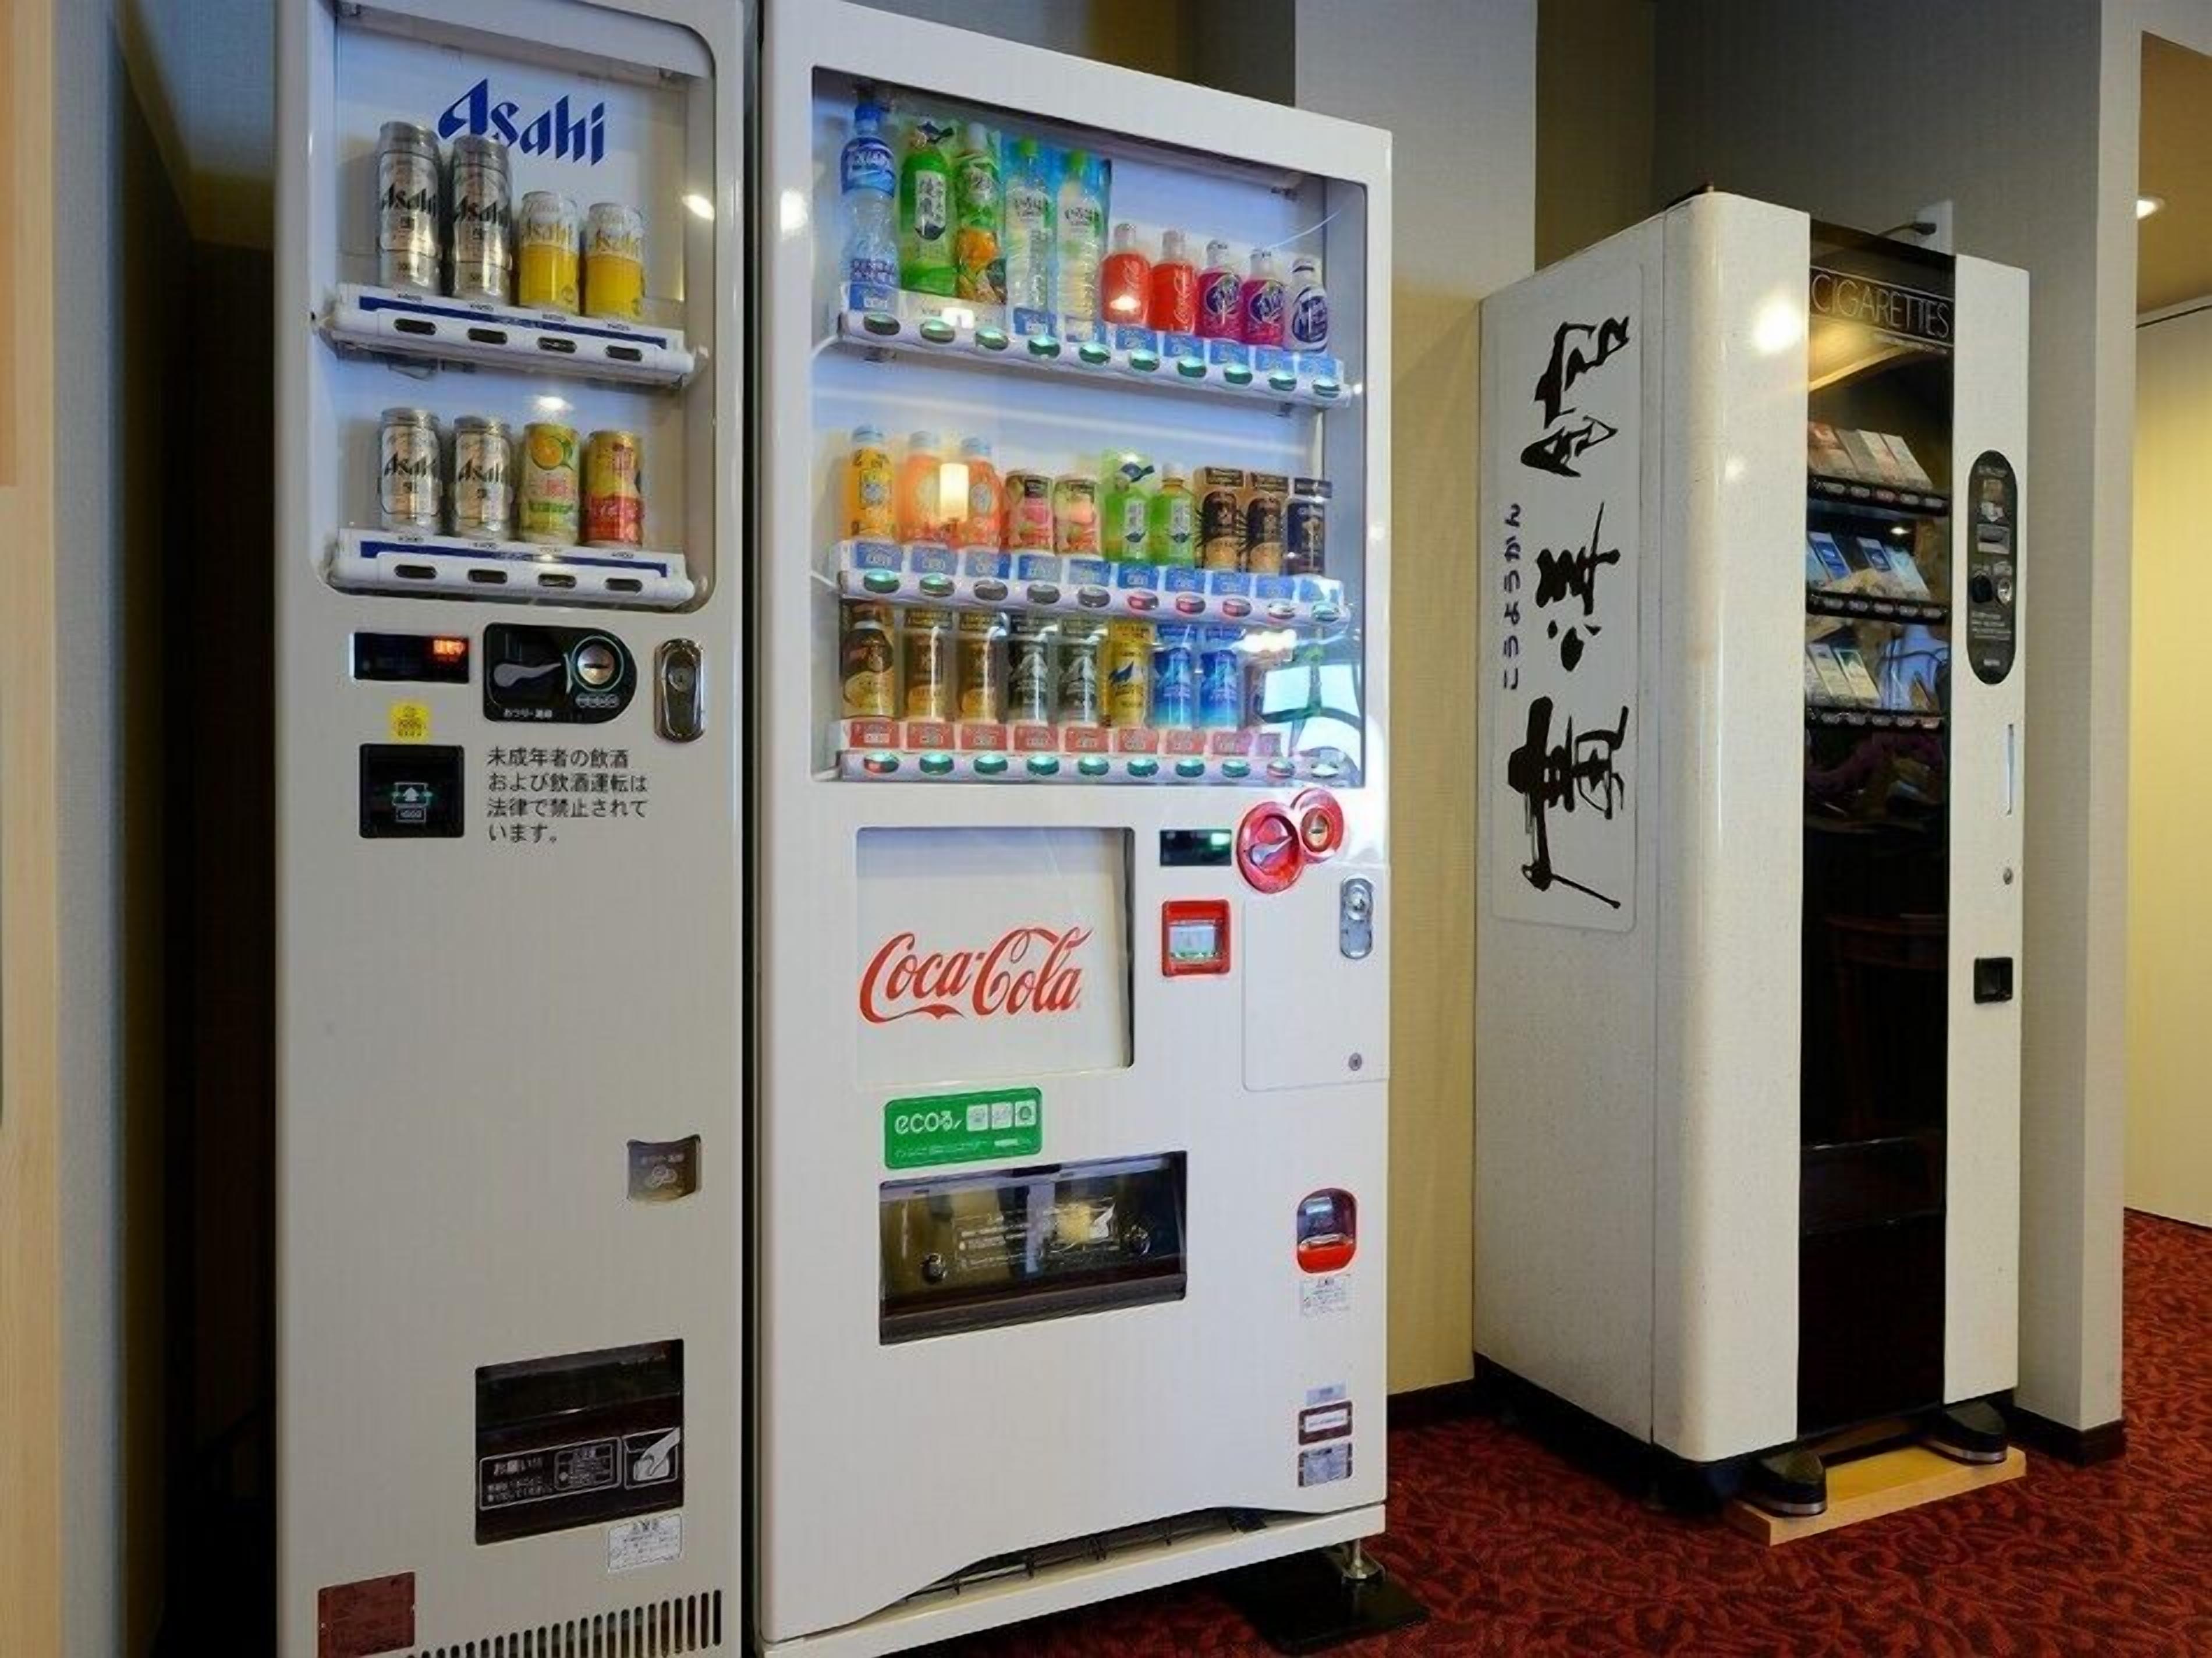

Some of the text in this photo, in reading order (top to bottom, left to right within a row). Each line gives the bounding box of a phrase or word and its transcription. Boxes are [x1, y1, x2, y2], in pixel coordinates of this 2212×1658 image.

[438, 78, 605, 166] Asahi
[1812, 273, 1950, 338] CIGARETTES
[1503, 503, 1521, 690] こうようかん
[487, 746, 629, 768] 未成年者の飲酒
[488, 773, 647, 792] および飲酒運転は
[487, 798, 648, 818] 法律で禁止されて
[488, 823, 557, 844] います。
[859, 927, 1094, 1024] Coca-Cola
